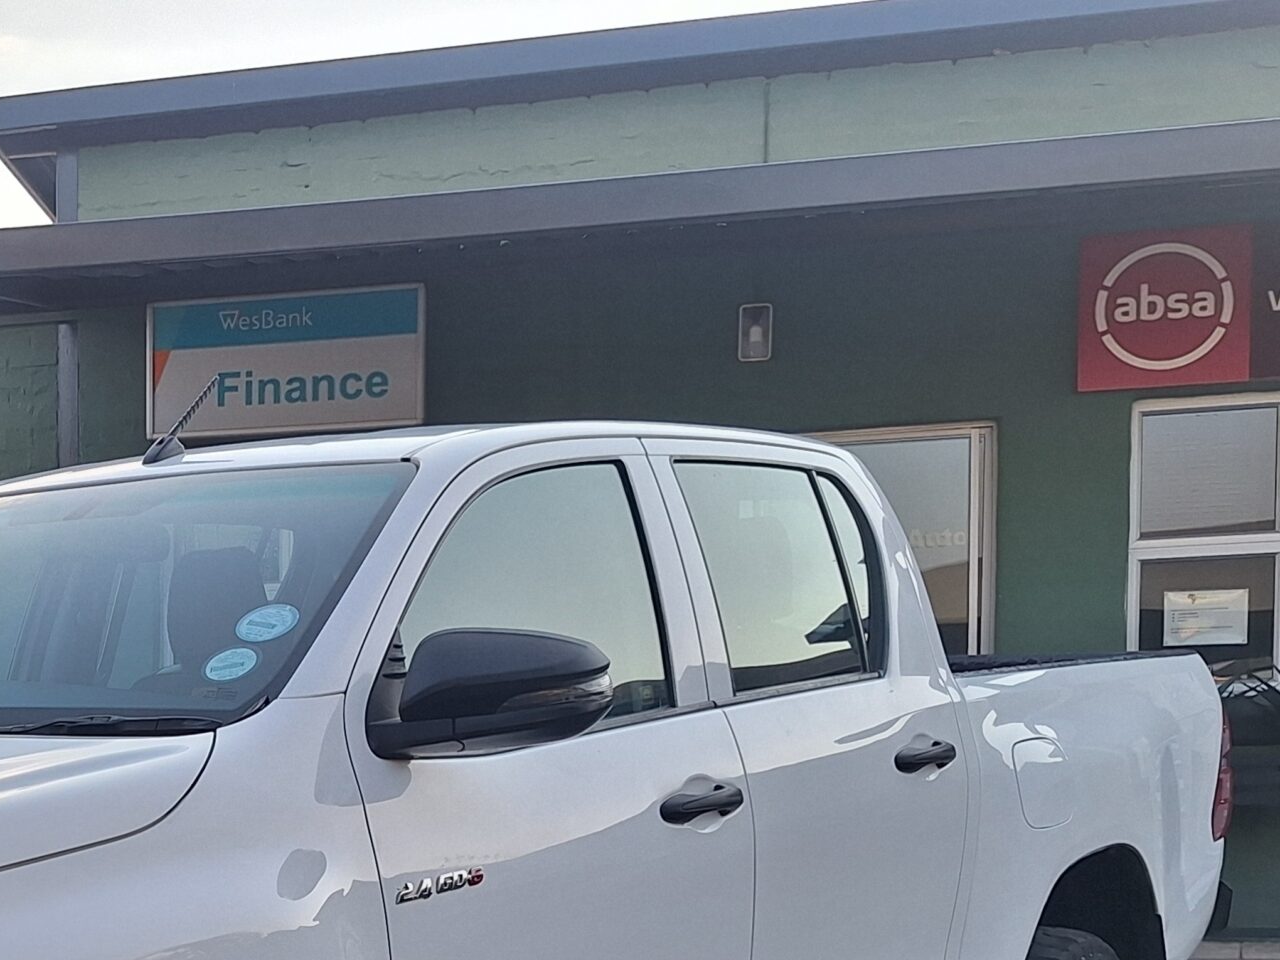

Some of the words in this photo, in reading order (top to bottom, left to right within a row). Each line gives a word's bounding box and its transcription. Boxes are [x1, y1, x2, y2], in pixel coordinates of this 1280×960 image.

[219, 306, 313, 331] WesBank
[1113, 283, 1216, 323] absa
[217, 370, 389, 407] Finance
[394, 881, 434, 905] 2.4
